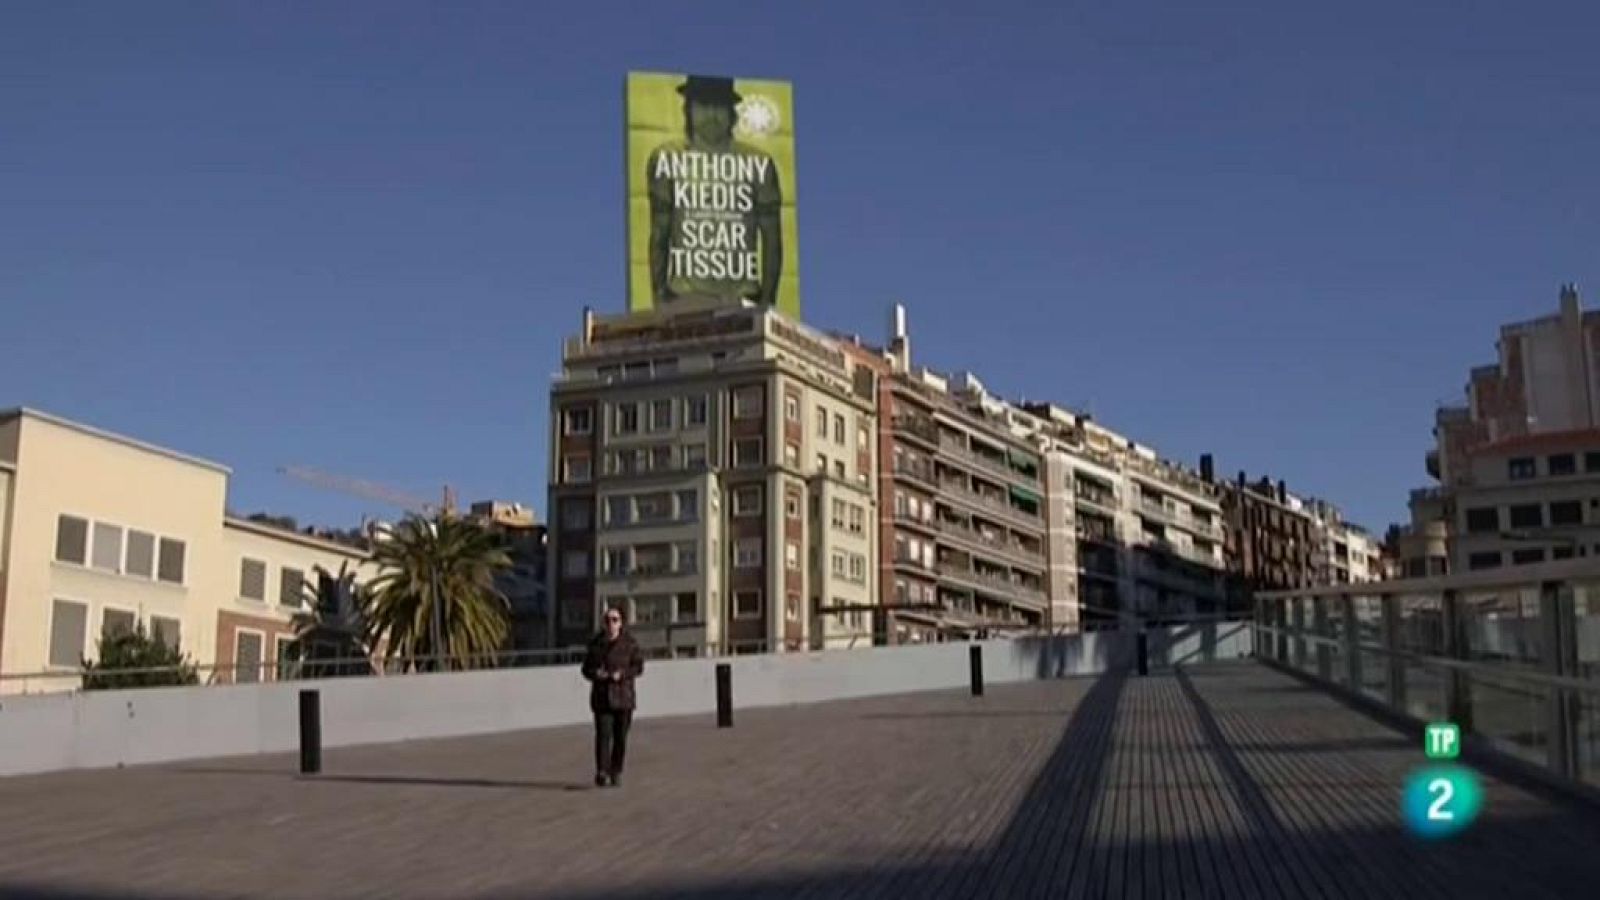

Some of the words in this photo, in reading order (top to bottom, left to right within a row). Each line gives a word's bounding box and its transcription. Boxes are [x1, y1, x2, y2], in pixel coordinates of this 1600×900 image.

[655, 152, 769, 183] ANTHONY
[674, 181, 753, 212] KIEDIS
[682, 220, 746, 250] SCAR
[671, 249, 760, 280] TISSUE
